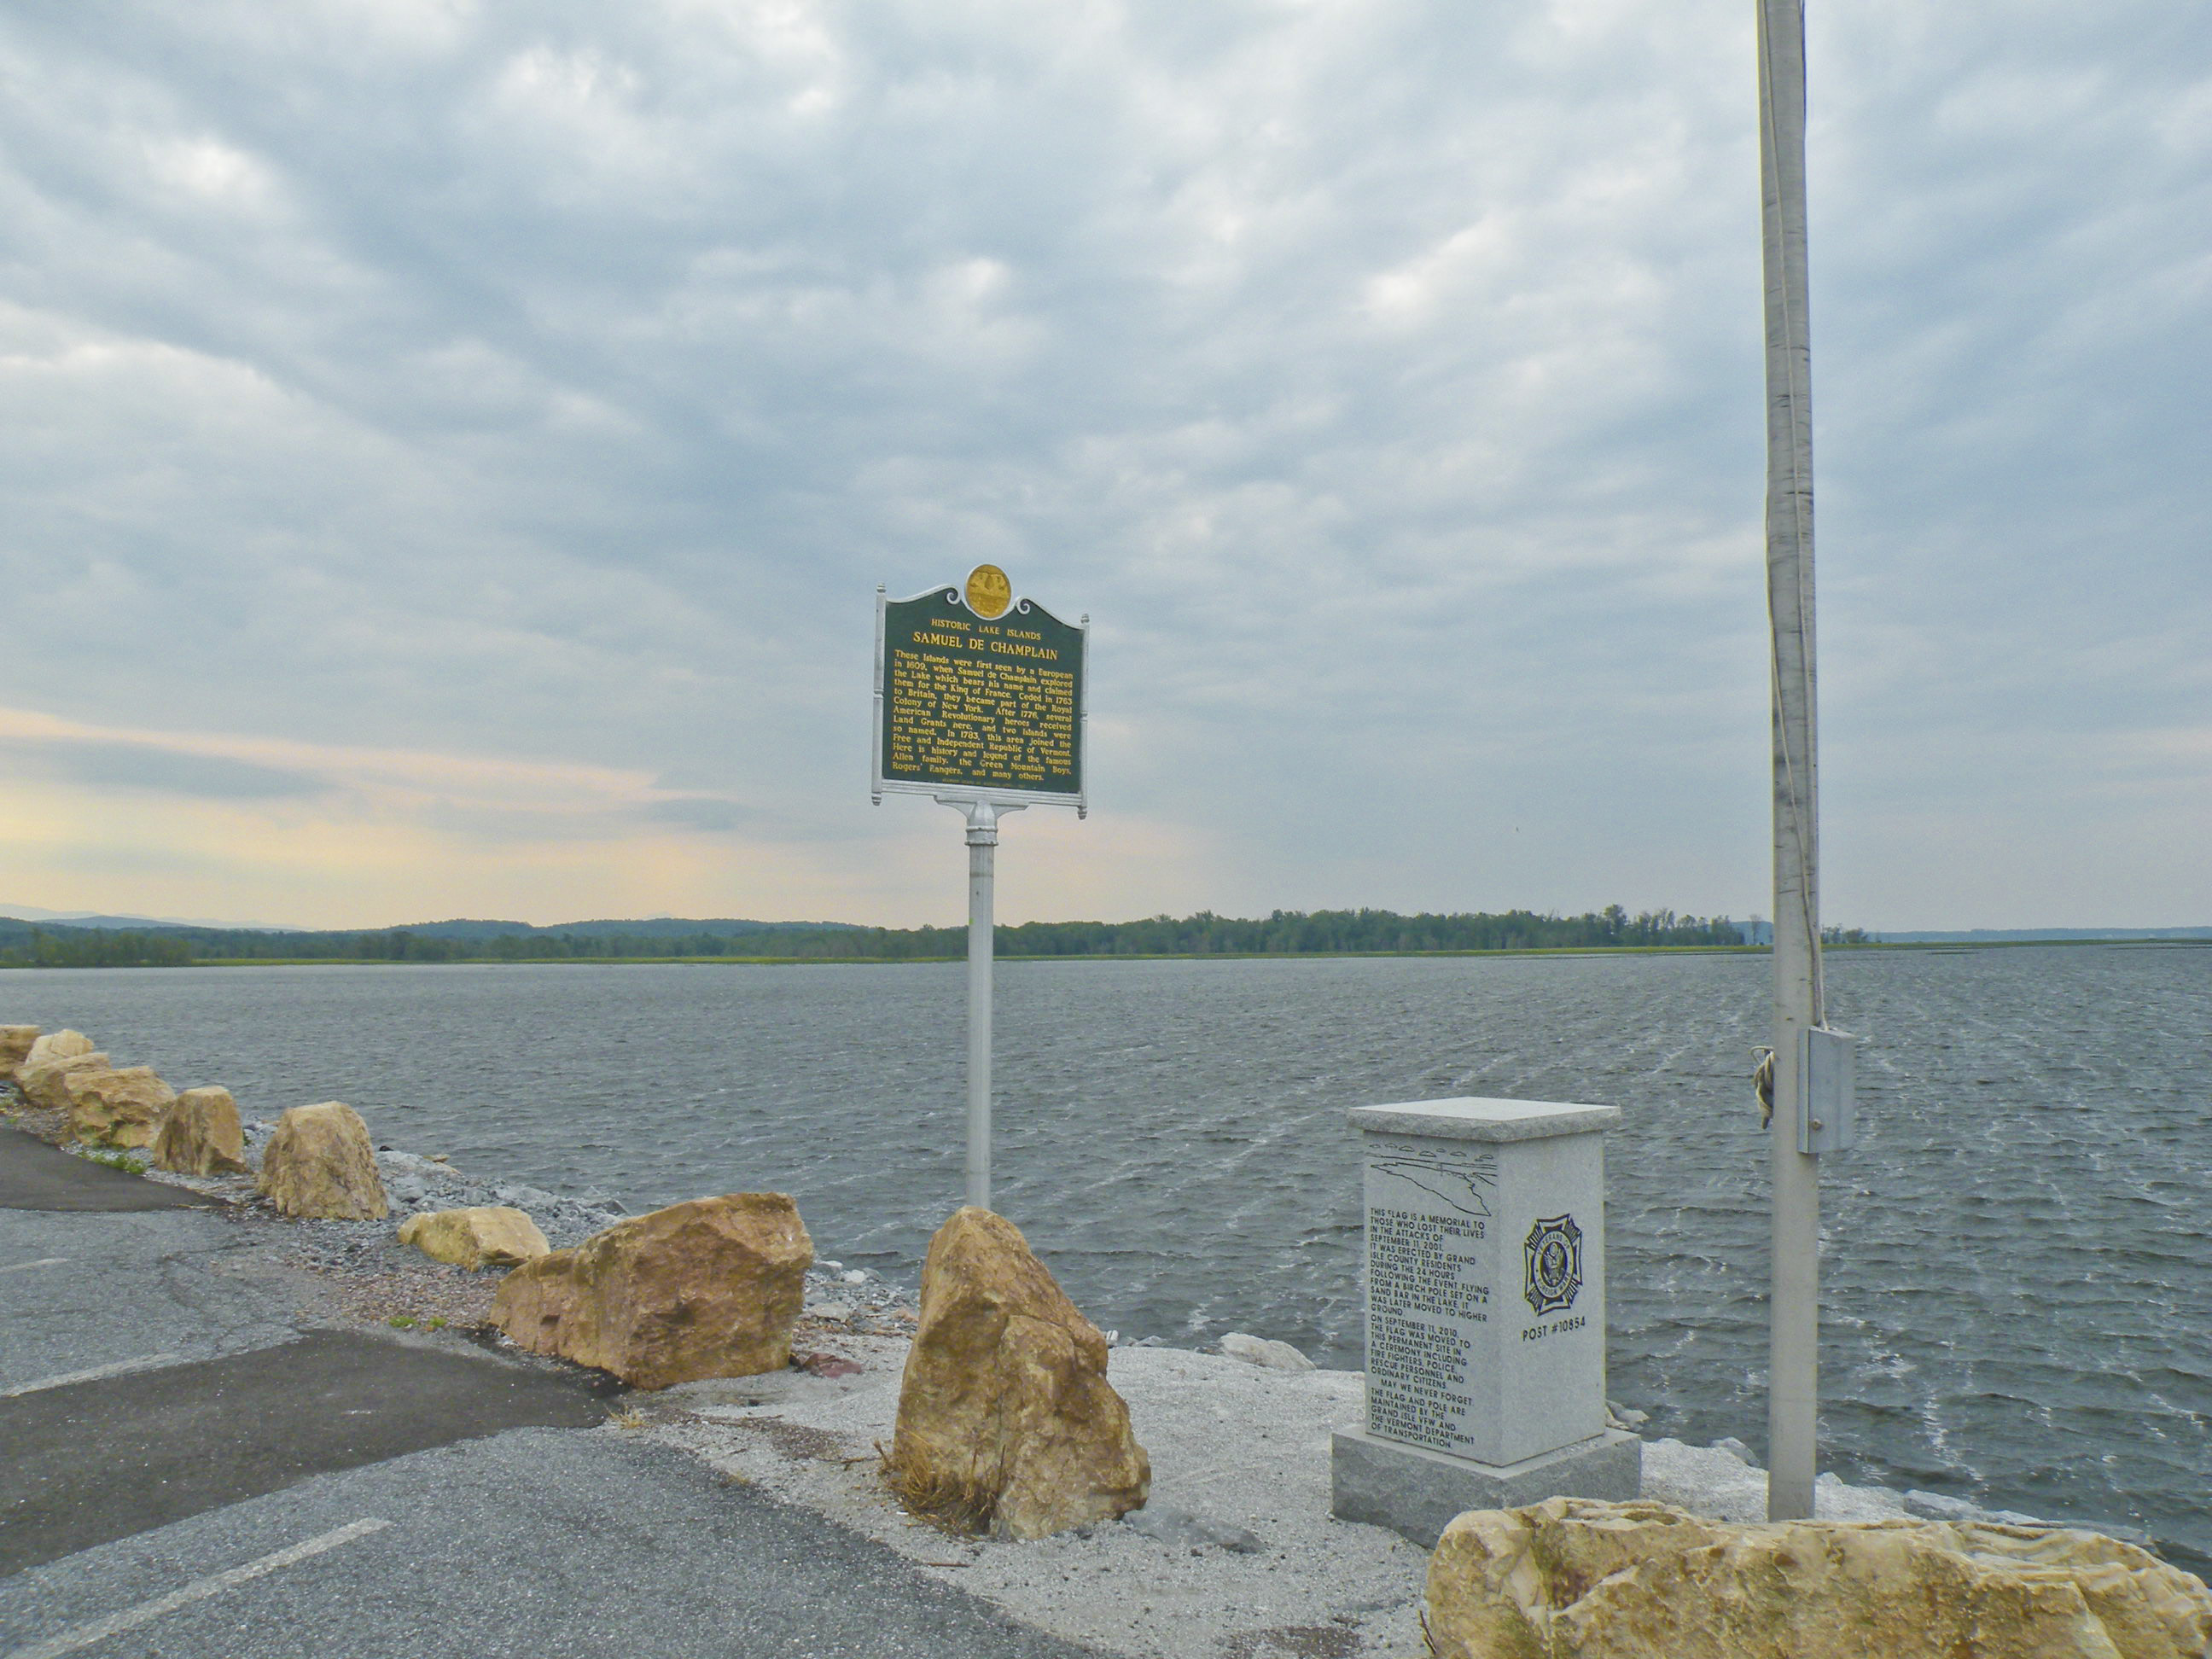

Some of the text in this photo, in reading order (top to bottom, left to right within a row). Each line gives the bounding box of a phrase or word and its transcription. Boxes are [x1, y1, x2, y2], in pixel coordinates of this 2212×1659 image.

[931, 618, 1041, 640] HISTORIC LAKE ISLANDS
[912, 632, 1058, 660] SAMUEL DE CHAMPLAIN
[894, 649, 919, 660] These
[976, 661, 992, 669] first
[1038, 668, 1074, 678] European
[911, 671, 931, 679] Lake
[934, 674, 958, 683] which
[963, 677, 985, 686] bears
[1004, 682, 1024, 690] name
[1045, 685, 1073, 696] claimed
[933, 665, 1073, 688] when Samuel Champlain explored
[917, 680, 930, 689] for
[950, 684, 969, 694] King
[1018, 693, 1042, 701] Ceded
[893, 696, 922, 707] Colony
[995, 707, 1016, 716] After
[1045, 713, 1072, 722] several
[943, 693, 961, 701] they
[964, 694, 995, 705] became
[1051, 704, 1072, 713] Royal
[893, 706, 1072, 731] American Revolutionary heroes received
[893, 715, 914, 724] Land
[920, 718, 946, 727] Grants
[893, 733, 911, 742] Free
[936, 737, 984, 748] Independent
[989, 742, 1022, 752] Republic
[893, 742, 912, 752] Here
[931, 747, 958, 756] history
[982, 751, 1008, 760] legend
[893, 752, 914, 760] Allen
[979, 759, 1004, 768] Green
[1010, 763, 1045, 771] Mountain
[1370, 1208, 1385, 1216] THIS
[1429, 1215, 1470, 1227] MEMORIAL
[1473, 1220, 1485, 1230] TO
[1370, 1216, 1485, 1239] THOSE WHO LOST THEIR LIVES
[1370, 1234, 1410, 1246] SEPTEMBER
[1380, 1226, 1393, 1235] THE
[1395, 1229, 1429, 1240] ATTACKS
[1370, 1251, 1462, 1272] ISLE COUNTY RESIDENTS
[1379, 1244, 1395, 1253] WAS
[1398, 1247, 1431, 1258] ERECTED
[1446, 1254, 1476, 1265] GRAND
[1370, 1260, 1455, 1280] DURING THE 24 HOURS
[1370, 1268, 1490, 1295] FOLLOWING THE FLYING
[1370, 1277, 1392, 1287] FROM
[1402, 1283, 1426, 1293] BIRCH
[1428, 1287, 1447, 1297] POLE
[1450, 1290, 1463, 1299] SET
[1371, 1285, 1435, 1304] SAND BAR THE
[1371, 1295, 1487, 1322] WAS LATER MOVED HIGHER
[1371, 1323, 1456, 1345] THE FLAG WAS MOVED
[1385, 1317, 1425, 1330] SEPTEMBER
[1522, 1325, 1547, 1342] POST
[1370, 1348, 1385, 1358] FIRE
[1371, 1331, 1450, 1353] THIS PERMANENT SITE
[1379, 1342, 1468, 1366] CEREMONY INCLUDING
[1371, 1357, 1464, 1383] RESCUE PERSONNEL AND
[1371, 1366, 1410, 1380] ORDINARY
[1381, 1379, 1438, 1398] MAY NEVER
[1371, 1387, 1466, 1416] THE FLAG AND POLE ARE
[1371, 1396, 1444, 1420] MAINTAINED THE
[1371, 1405, 1457, 1431] GRAND ISLE VFW AND
[1371, 1413, 1475, 1444] THE VERMONT DEPARTMENT
